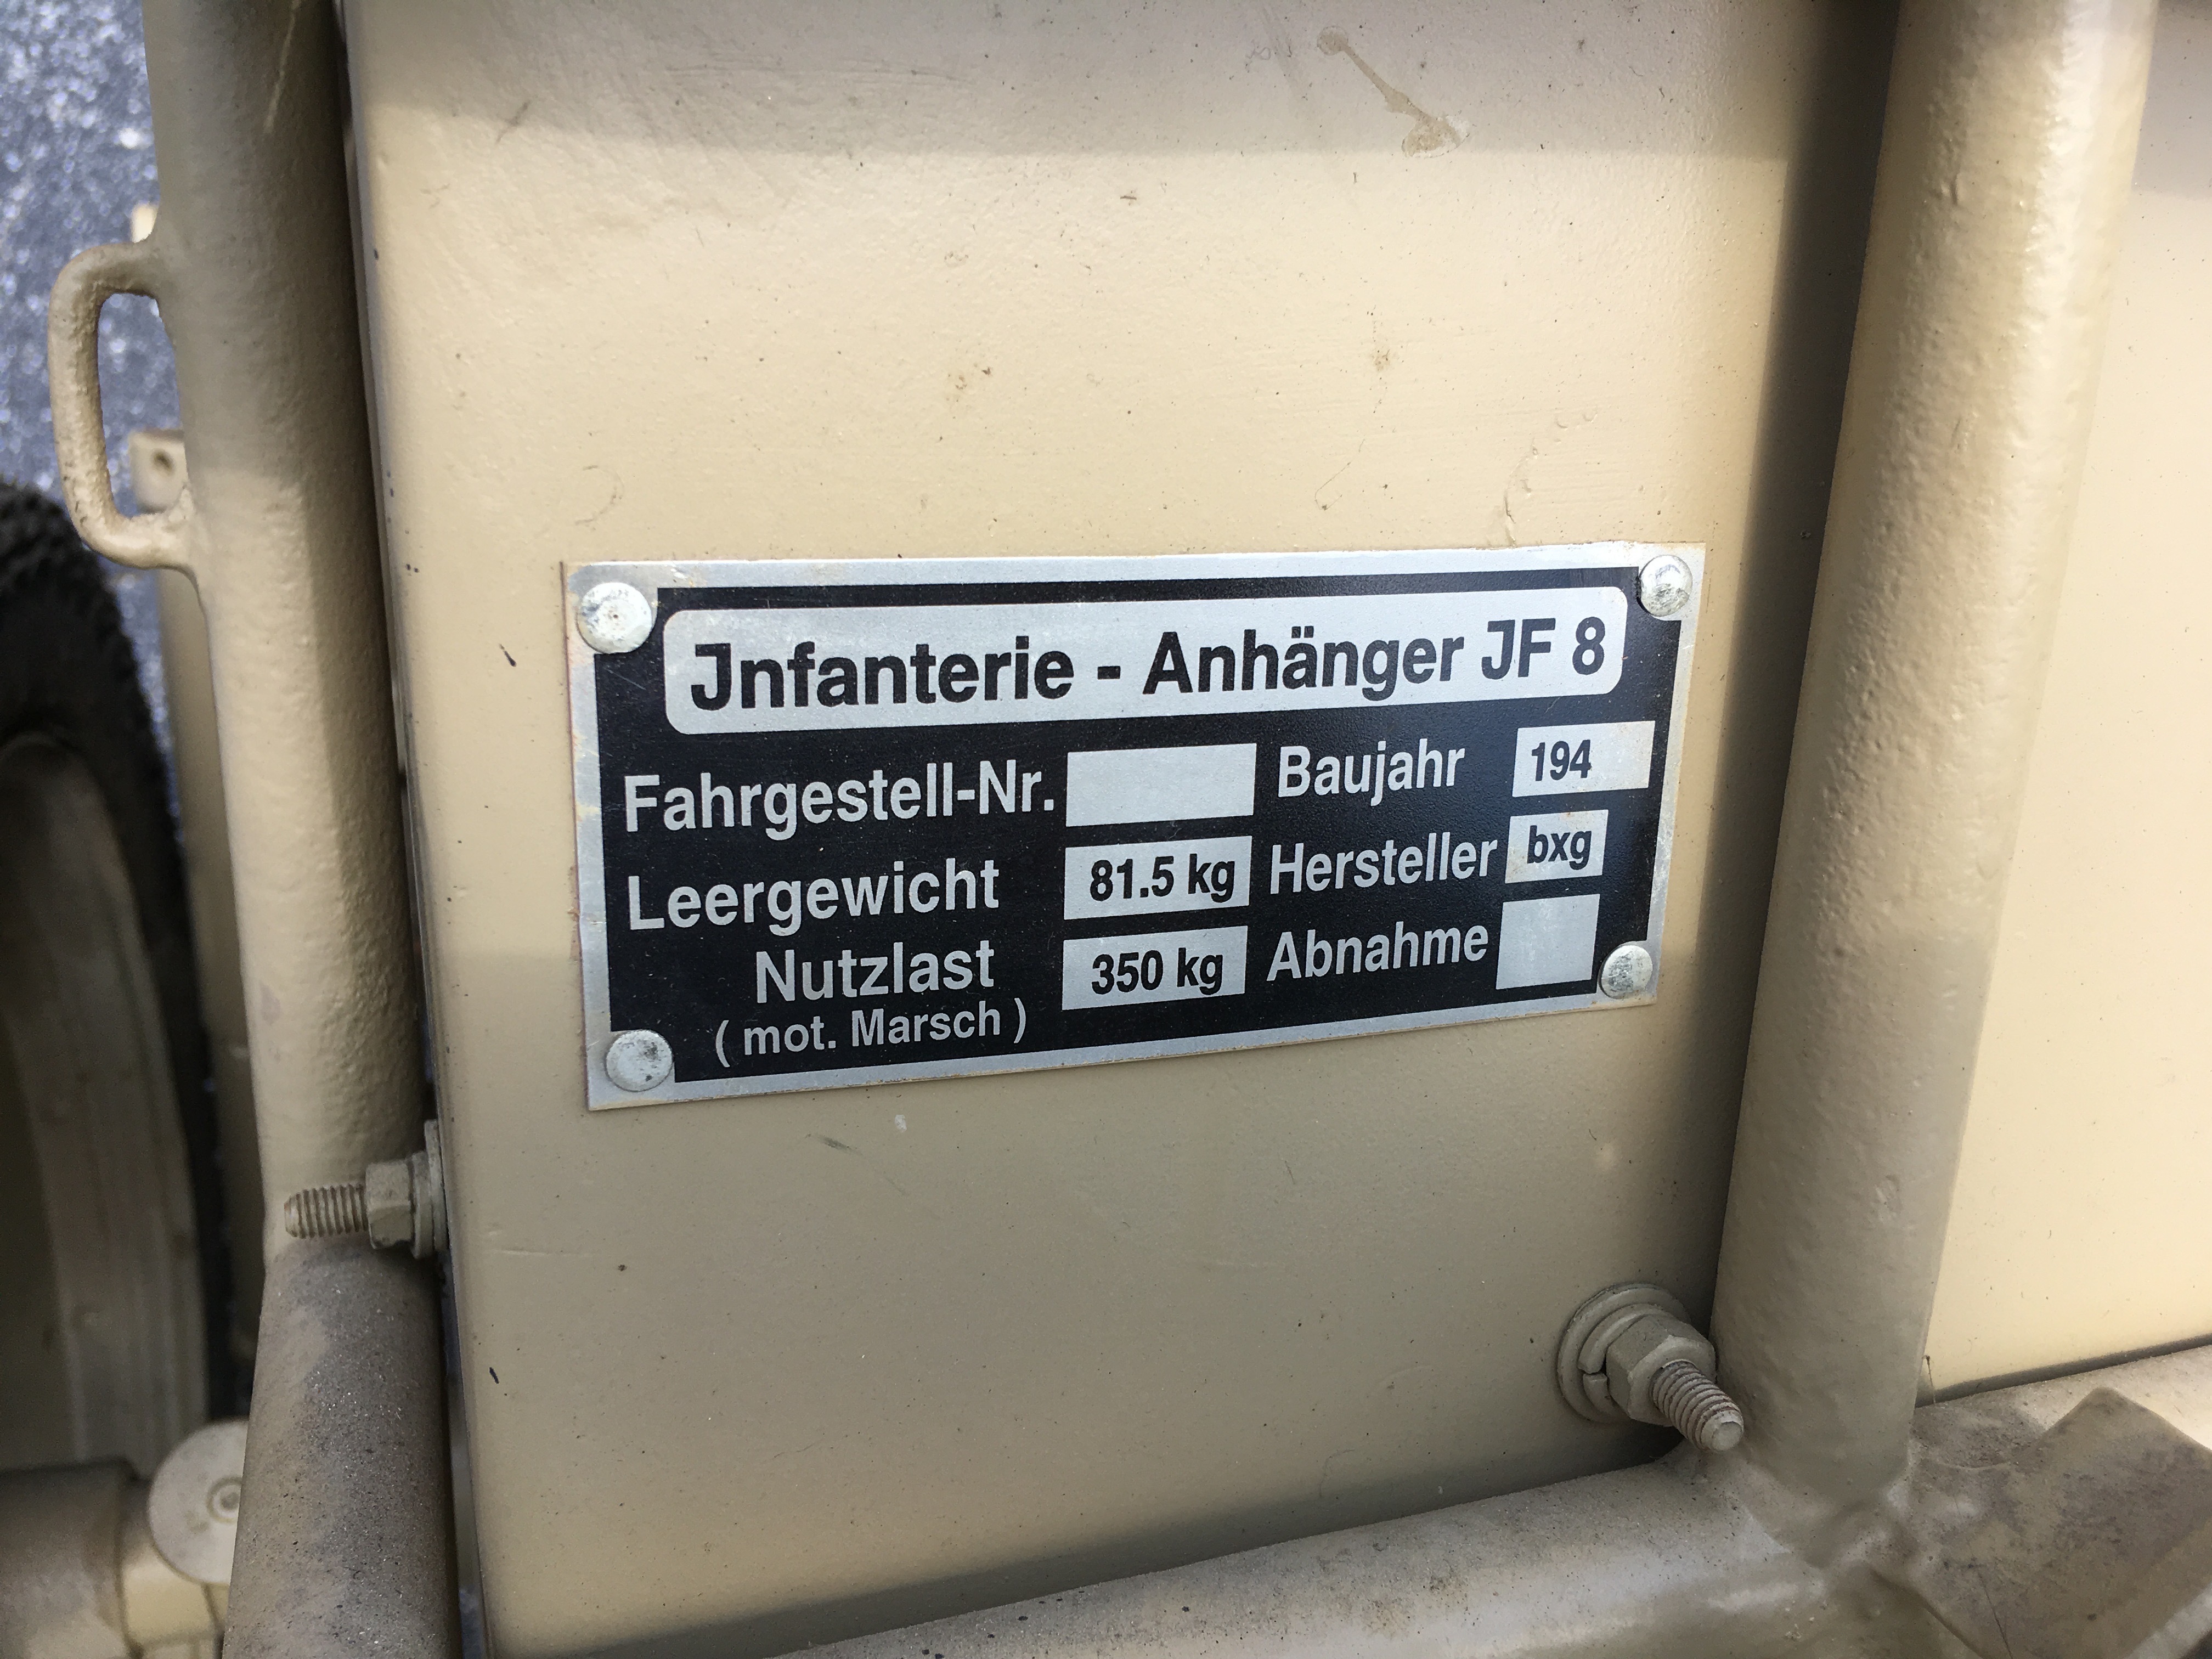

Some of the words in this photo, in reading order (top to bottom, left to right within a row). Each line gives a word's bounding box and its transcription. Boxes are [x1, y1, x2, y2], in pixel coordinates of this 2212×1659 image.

[691, 636, 1074, 710] Jnfanterie
[1143, 626, 1464, 701] Anhänger
[1482, 618, 1556, 680] JF
[1572, 617, 1605, 675] 8
[625, 760, 1054, 840] Fahrgestell-Nr.
[1278, 738, 1465, 806] Baujahr
[1532, 740, 1592, 781] 194
[1271, 832, 1498, 894] Hersteller
[1527, 825, 1592, 870] bxg
[629, 858, 999, 936] Leergewicht
[1090, 856, 1174, 901] 81.5
[1188, 854, 1235, 903] kg
[757, 940, 994, 1003] Nutzlast
[1092, 950, 1163, 995] 350
[1177, 947, 1223, 995] kg
[1267, 921, 1488, 981] Abnahme
[744, 1016, 836, 1055] mot.
[852, 1001, 1000, 1046] Marsch
